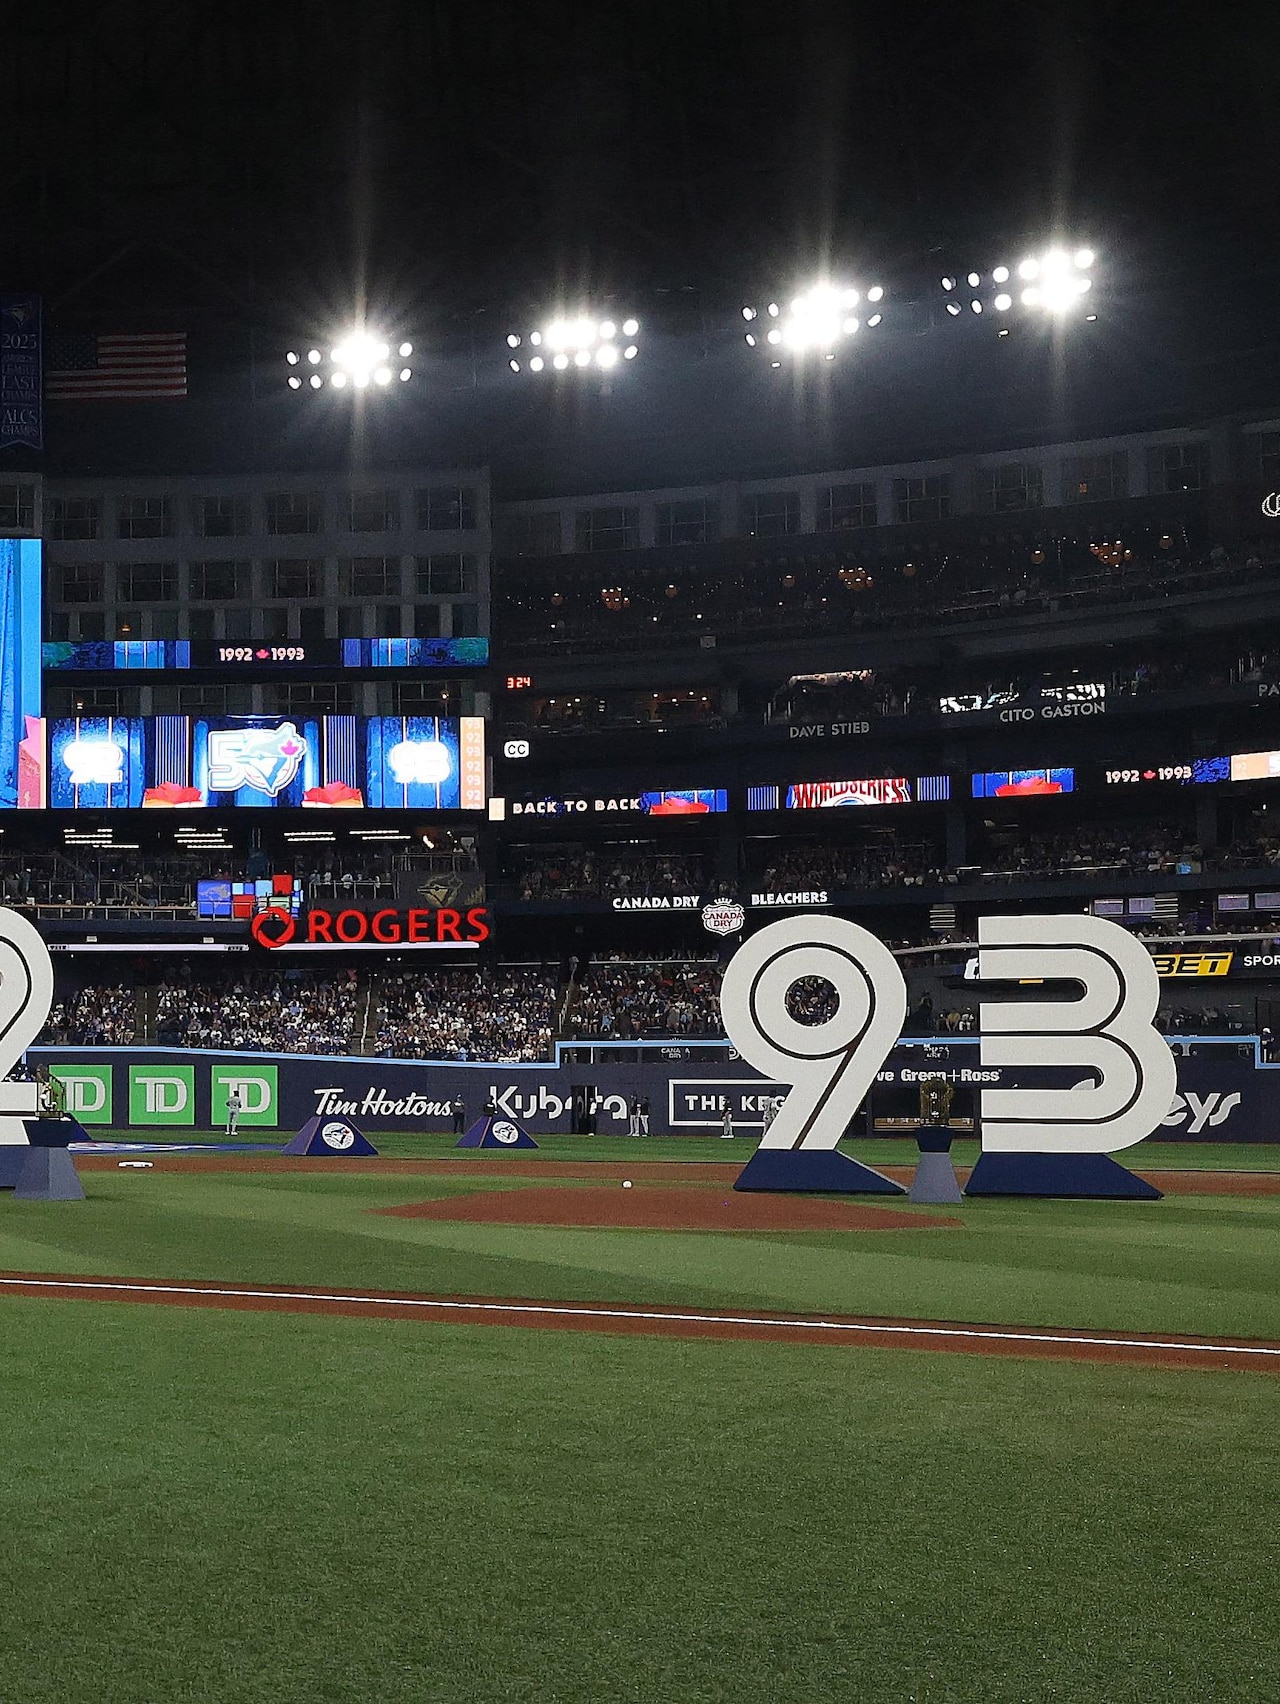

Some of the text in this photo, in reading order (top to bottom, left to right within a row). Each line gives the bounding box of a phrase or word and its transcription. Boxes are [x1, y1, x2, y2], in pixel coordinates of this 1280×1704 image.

[2, 333, 37, 349] 2025
[2, 408, 38, 425] ALCS
[220, 646, 305, 662] 1992 1993
[1258, 684, 1280, 697] PA
[1000, 701, 1106, 723] CITO GASTON
[466, 732, 481, 743] 92
[790, 721, 870, 739] DAVE STIEB
[508, 744, 526, 755] CC
[466, 761, 481, 772] 92
[466, 774, 481, 786] 93
[1105, 766, 1193, 784] 1992 1993
[466, 789, 482, 800] 92
[513, 798, 641, 815] BACK TO BACK
[613, 896, 700, 909] CANADA DRY
[751, 892, 828, 906] BLEACHERS
[704, 912, 744, 920] CANADA
[713, 920, 734, 928] DRY
[308, 908, 490, 942] ROGERS
[1153, 955, 1230, 974] BET
[57, 1076, 106, 1112] TD
[135, 1077, 188, 1113] TD
[218, 1077, 272, 1114] TD
[314, 1086, 453, 1117] Tim Hortons
[489, 1086, 627, 1120] Kuba
